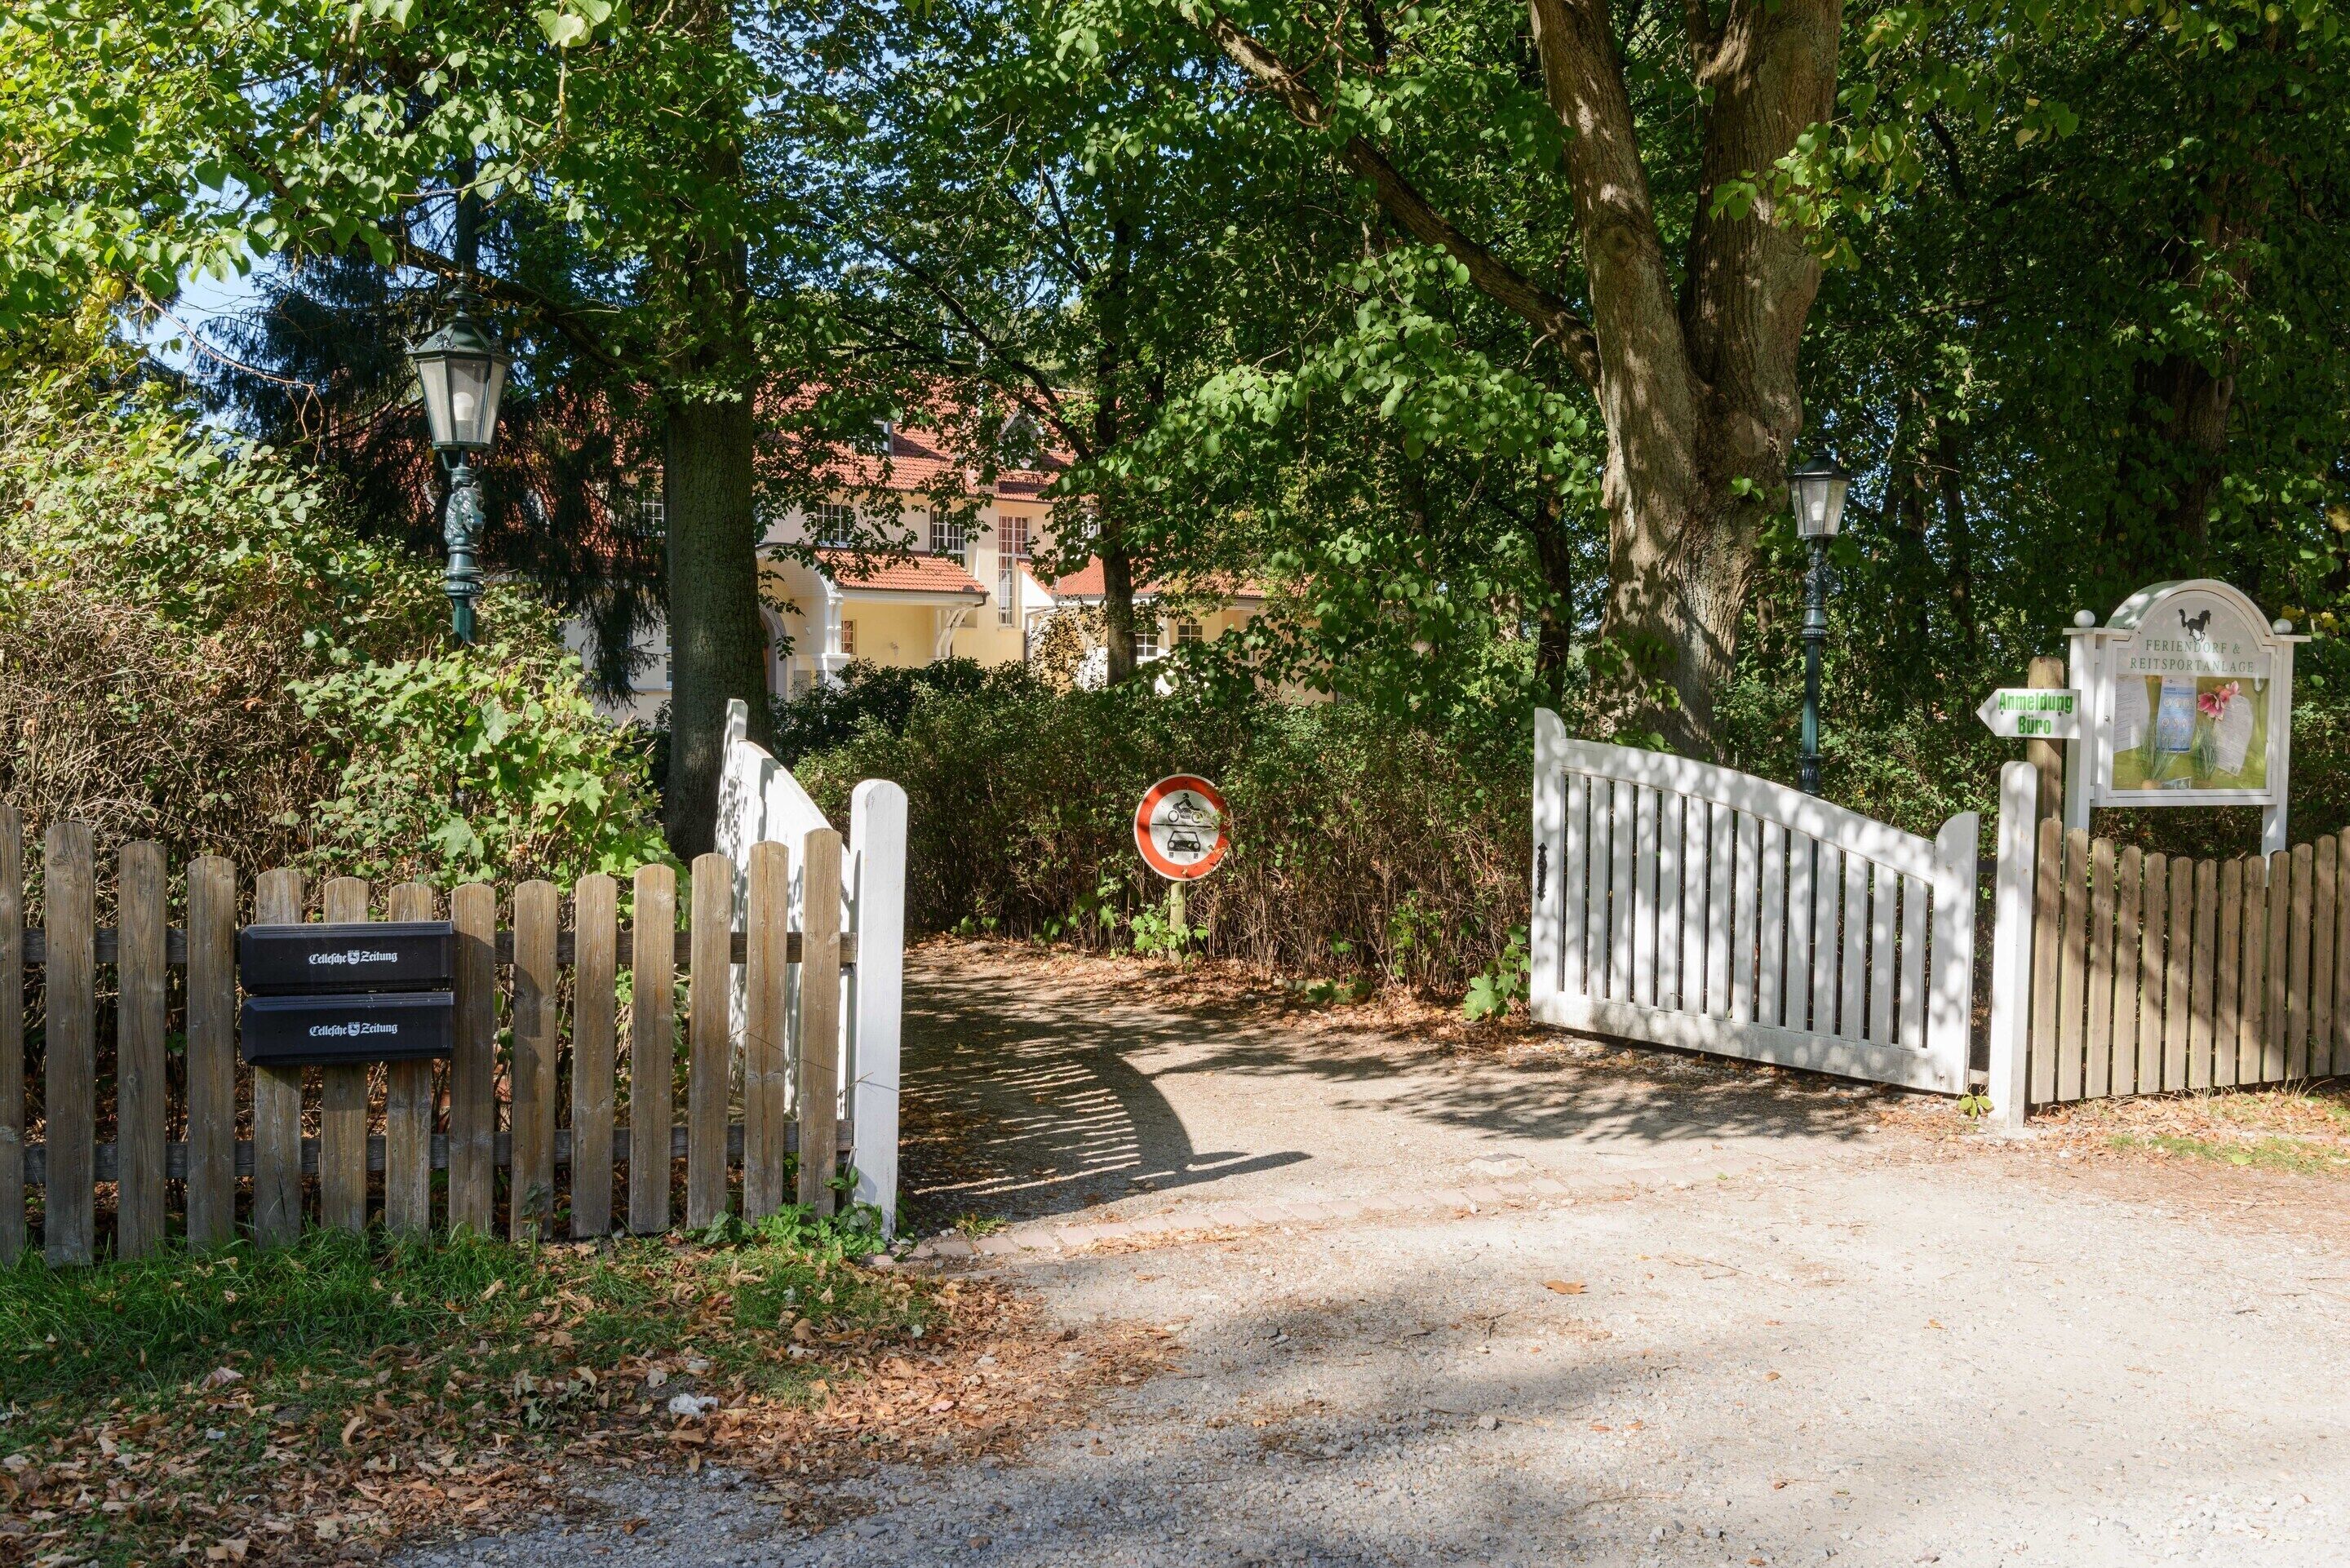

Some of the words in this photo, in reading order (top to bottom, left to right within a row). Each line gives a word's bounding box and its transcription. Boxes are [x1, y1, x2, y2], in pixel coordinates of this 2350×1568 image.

[2146, 640, 2227, 653] FERIENDORF
[2232, 644, 2241, 654] &
[2130, 658, 2254, 673] REITSPORTANLAGE
[1998, 692, 2073, 714] Anmeldung
[2018, 714, 2051, 734] Büro
[360, 950, 398, 963] Zeitung
[360, 1022, 398, 1034] Zeitung
